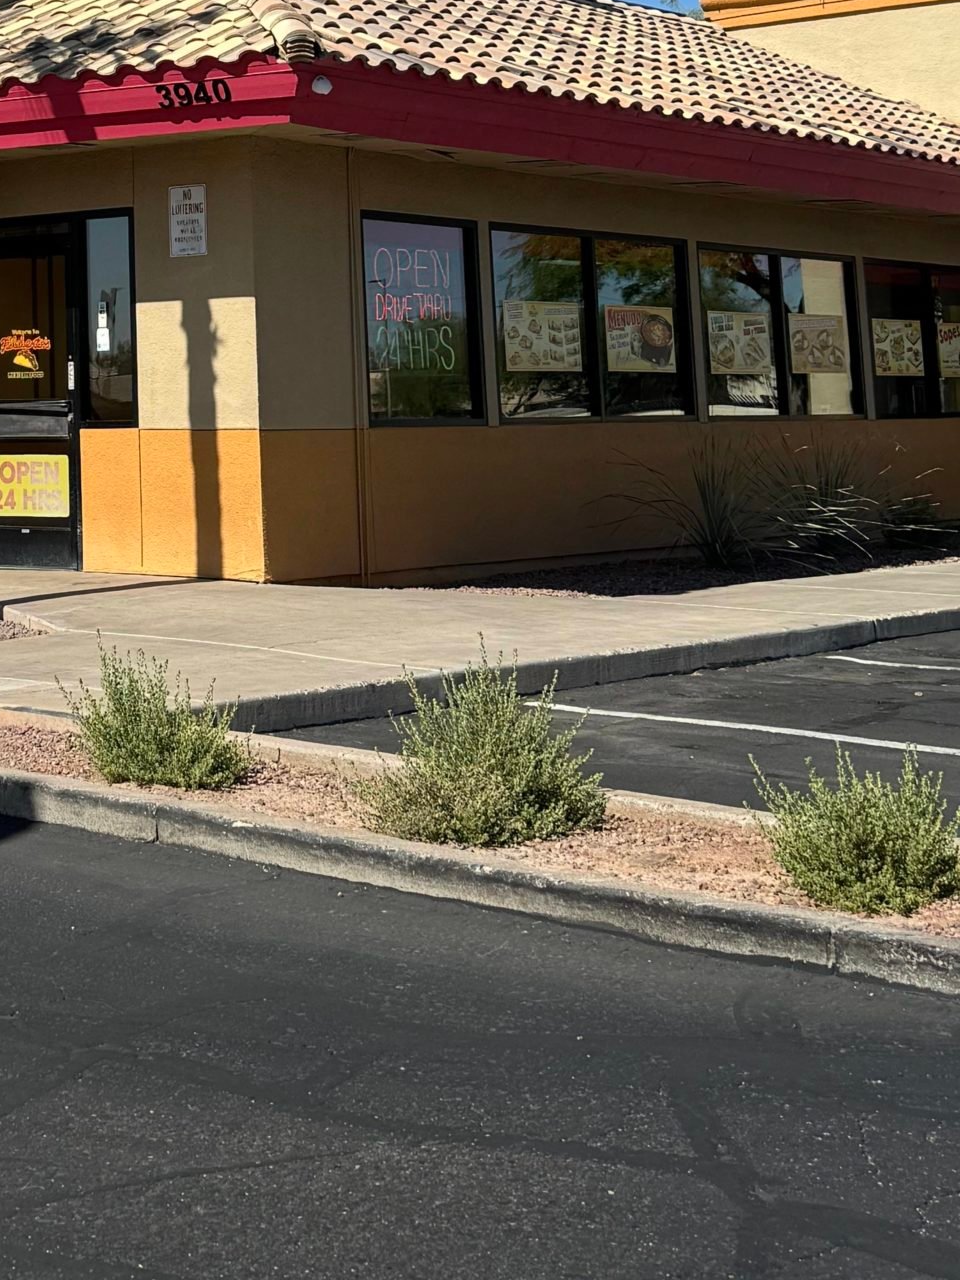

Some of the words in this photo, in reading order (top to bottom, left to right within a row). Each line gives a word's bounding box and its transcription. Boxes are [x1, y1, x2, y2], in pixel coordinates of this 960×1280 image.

[155, 79, 232, 108] 3940
[182, 189, 192, 201] NO
[171, 202, 204, 216] LOITERING
[374, 247, 450, 289] OPEN
[404, 325, 455, 371] HRS
[0, 461, 59, 484] OPEN
